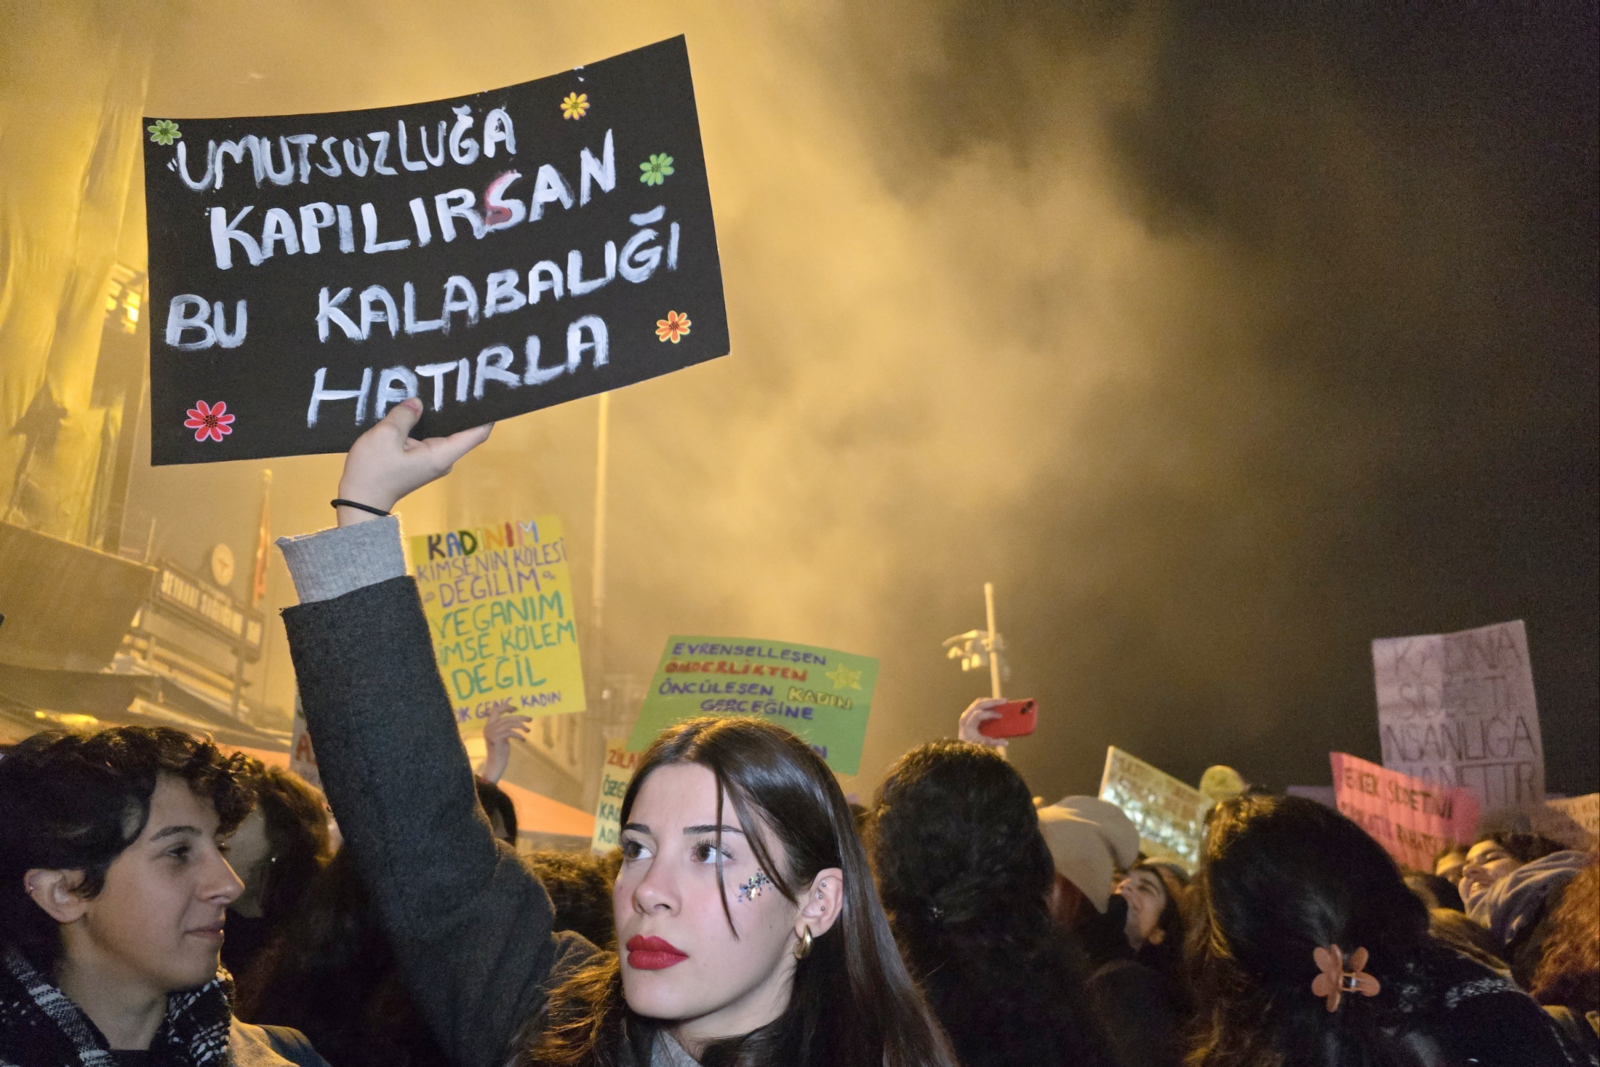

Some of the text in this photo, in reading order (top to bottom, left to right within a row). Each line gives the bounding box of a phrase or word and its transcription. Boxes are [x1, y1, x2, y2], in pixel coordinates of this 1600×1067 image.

[177, 104, 517, 191] UMUTSUZLUĞA
[208, 128, 616, 271] KAPILIRSAN
[165, 204, 682, 350] BU KALABALIĞI
[306, 314, 611, 429] HATIRLA
[451, 653, 548, 701] DEĞİL
